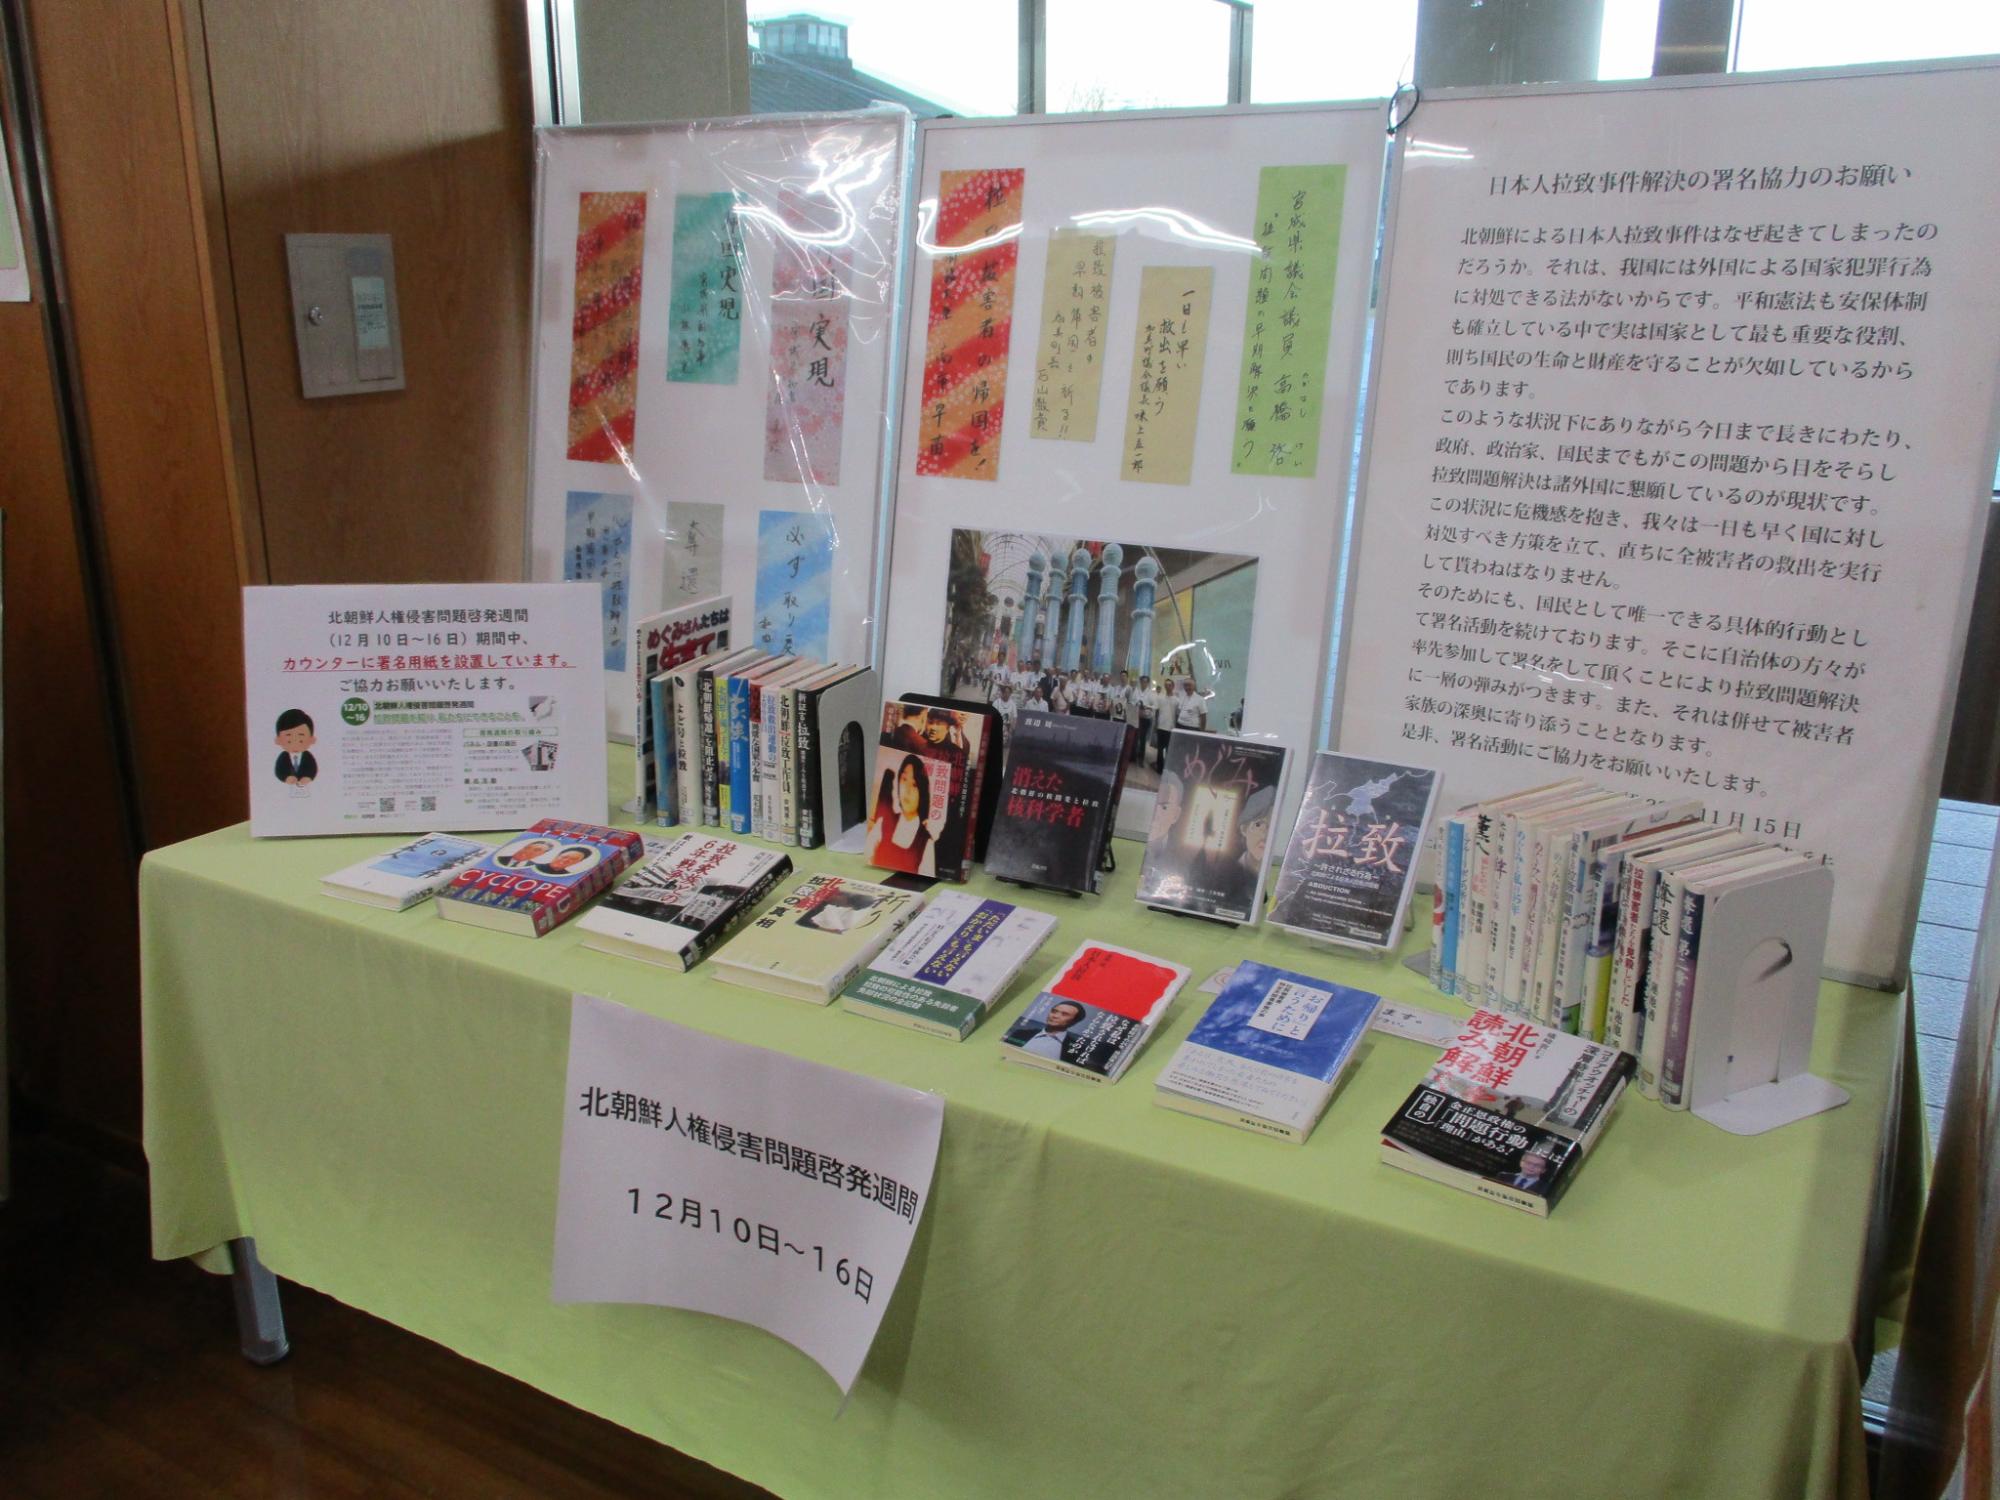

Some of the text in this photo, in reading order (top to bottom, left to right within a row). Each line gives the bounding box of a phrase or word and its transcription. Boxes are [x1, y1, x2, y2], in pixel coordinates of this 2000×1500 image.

[1489, 163, 1912, 196] 日本人拉致事件解決の署名協力のお願い
[1460, 220, 1938, 246] 北朝鮮による日本人拉致事件はなぜ起きてしまったの
[1457, 257, 1933, 279] だろうか。それは、我国には外国による国家犯罪行為
[1453, 289, 1928, 313] に対処できる法がないからです。平和憲法も安保体制
[1451, 318, 1908, 347] も確立している中で実は国家として最も重要な役割、
[1446, 348, 1914, 381] 則ち国民の生命と財産を守ることが欠如しているから
[1444, 378, 1536, 400] であります。
[1440, 409, 1912, 450] このような状況下にありながら今日まで長きにわたり、
[1435, 437, 1897, 482] 政府、政治家、国民までもがこの問題から目をそらし
[1431, 466, 1879, 517] 拉致問題解決は諸外国に懇願しているのが現状です。
[1429, 497, 1885, 549] この状況に危機感を抱き、我々は一日も早く国に対し
[1423, 553, 1621, 591] して貰わねばなりません。
[1424, 524, 1883, 584] 対処すべき方策を立て、直ちに全被害者の救出を実行
[328, 608, 529, 625] 北朝鮮人権侵害問題啓発週間
[647, 608, 730, 650] めぐみさんたちは
[1418, 582, 1868, 647] そのためにも、国民として唯一できる具体的行動とし
[282, 653, 569, 671] カウンターに署名用紙を設置しています。
[1415, 611, 1866, 679] て署名活動を続けております。そこに自治体の方々が
[339, 677, 516, 693] ご協力お願いいたします。
[1412, 638, 1861, 714] 率先参加して署名をして頂くことにより拉致問題解決
[1404, 695, 1713, 757] 家族の深奥に寄り添うこととなります。
[1408, 668, 1855, 746] に一層の弾みがつきます。また、それは併せて被害者
[1012, 766, 1064, 791] 消えた
[1183, 744, 1259, 800] めぐみ
[1402, 723, 1768, 798] 是非、署名活動にご協力をお願いいたします。
[1007, 797, 1085, 828] 核科学者
[1302, 808, 1406, 872] 拉致
[459, 869, 568, 899] CYCLOPE
[1450, 1101, 1527, 1134] 金正恩政権の
[579, 1085, 919, 1226] 北朝鮮人権侵害問題啓発週間
